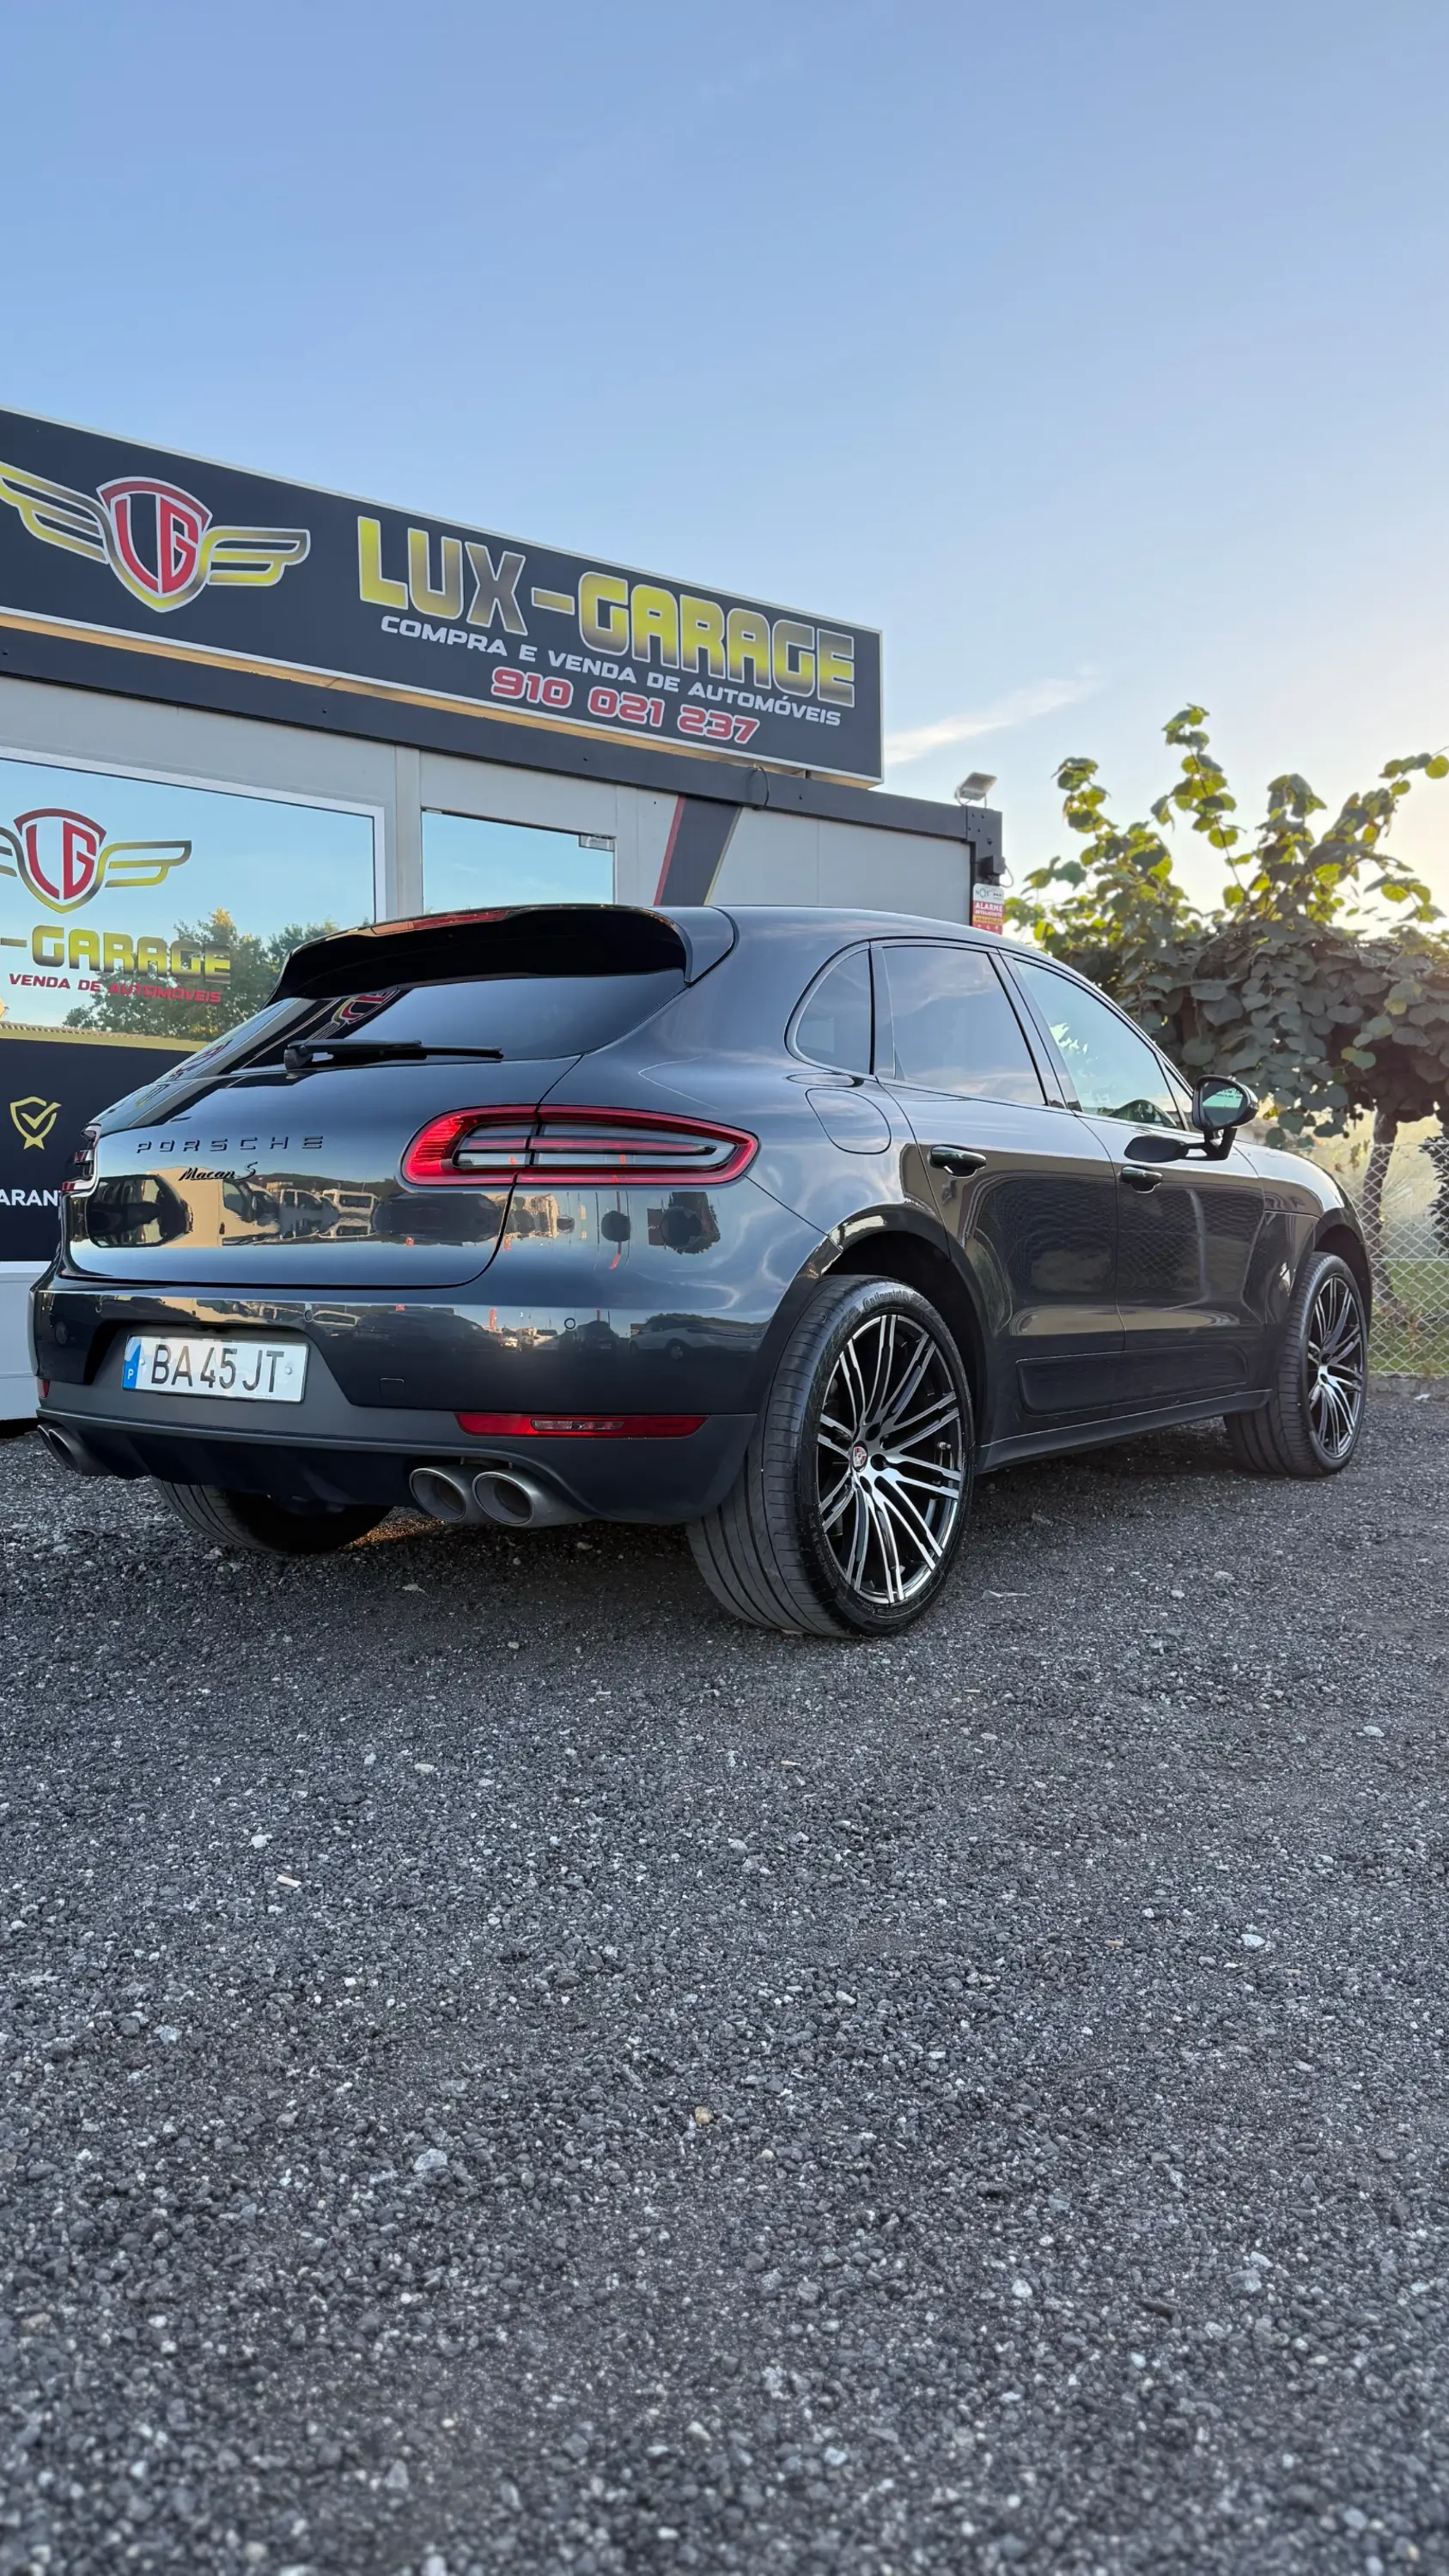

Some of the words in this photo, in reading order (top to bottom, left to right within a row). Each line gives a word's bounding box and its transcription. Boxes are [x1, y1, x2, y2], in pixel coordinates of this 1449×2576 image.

[357, 516, 855, 708] LUX-GARAGE
[381, 615, 508, 657] COMPRA
[519, 645, 538, 663] E
[548, 650, 636, 684] VENDA
[647, 671, 680, 692] DE
[688, 678, 841, 726] AUTOMÓVEIS
[491, 666, 573, 709] 910
[588, 687, 665, 728] 021
[677, 702, 760, 745] 237
[975, 902, 1003, 912] ALARME
[9, 973, 70, 989] VENDA
[78, 979, 101, 992] DE
[108, 982, 222, 1003] AUTOMÓVEIS
[137, 1135, 325, 1154] PORSCHE
[178, 1166, 235, 1182] Macan
[238, 1161, 259, 1181] S
[0, 1188, 62, 1207] ARAN
[127, 1369, 134, 1380] P
